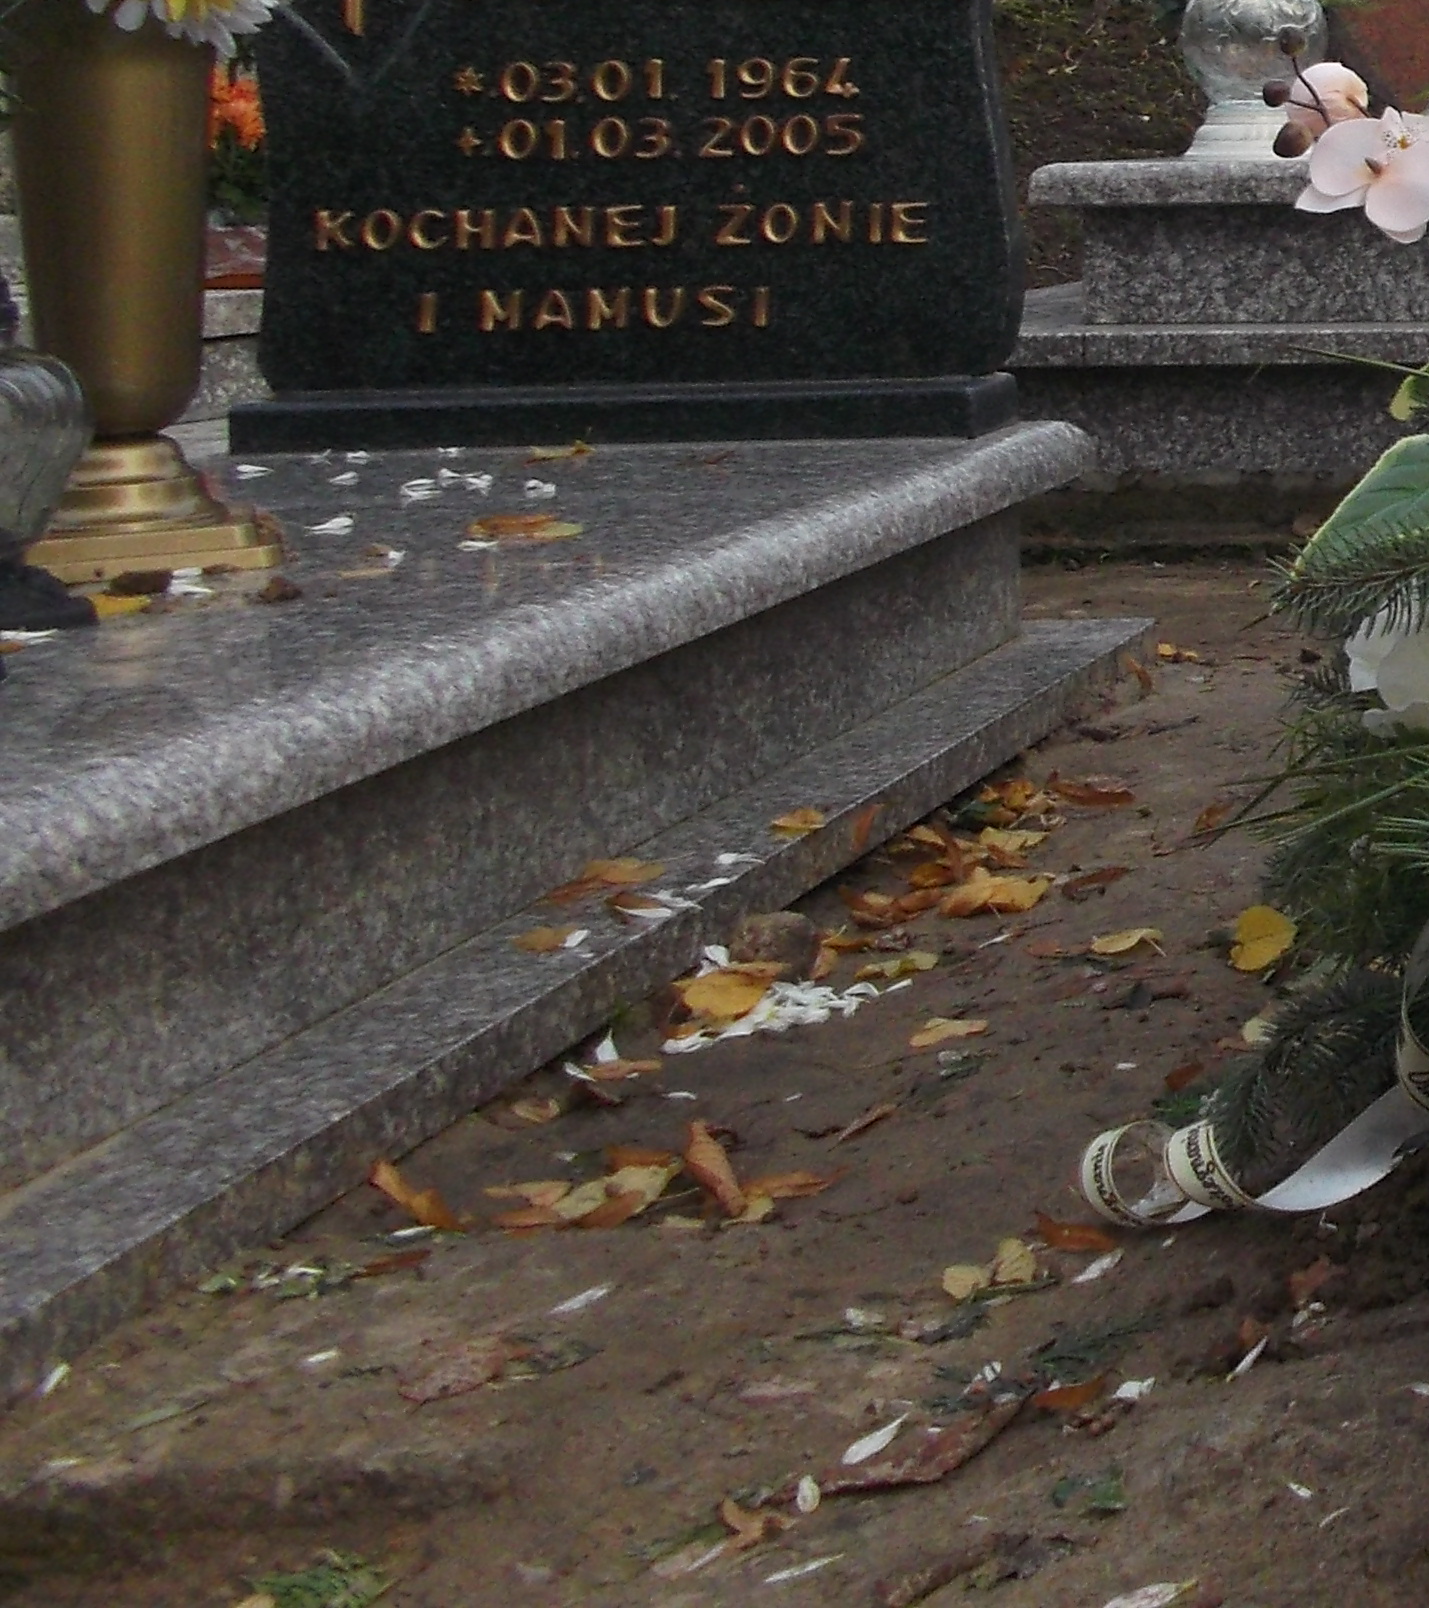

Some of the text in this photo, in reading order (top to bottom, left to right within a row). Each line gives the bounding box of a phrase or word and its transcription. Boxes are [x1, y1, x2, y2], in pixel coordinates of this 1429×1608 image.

[314, 183, 930, 251] KOCHANEJ ŻONIE
[416, 284, 770, 334] I MAMUSI
